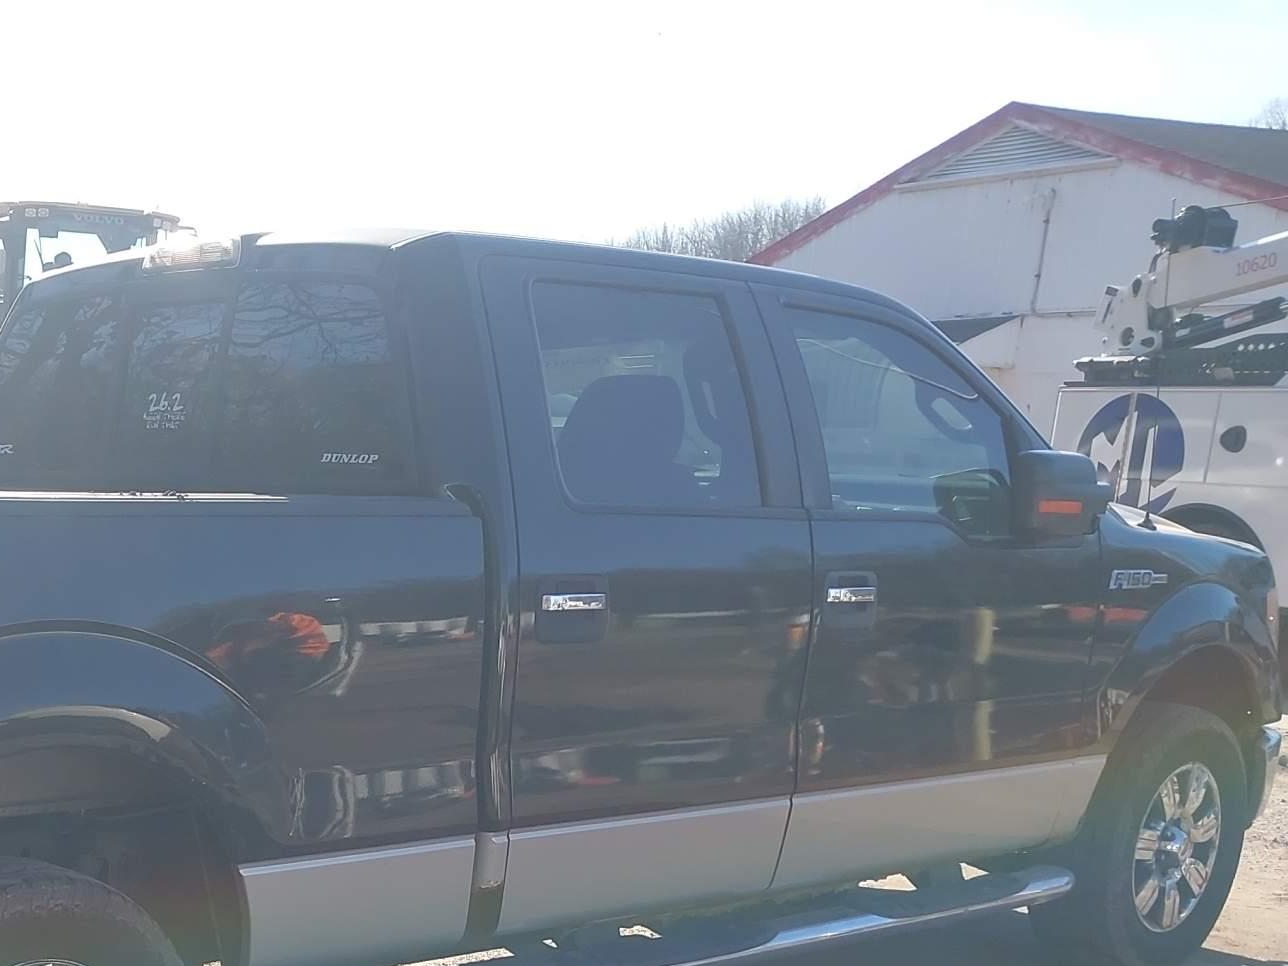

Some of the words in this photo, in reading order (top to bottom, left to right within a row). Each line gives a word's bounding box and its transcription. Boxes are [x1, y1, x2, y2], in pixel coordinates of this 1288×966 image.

[72, 212, 124, 225] VOLVO
[1235, 252, 1279, 277] 10620
[148, 391, 184, 411] 26.2
[320, 453, 379, 464] DUNLOP
